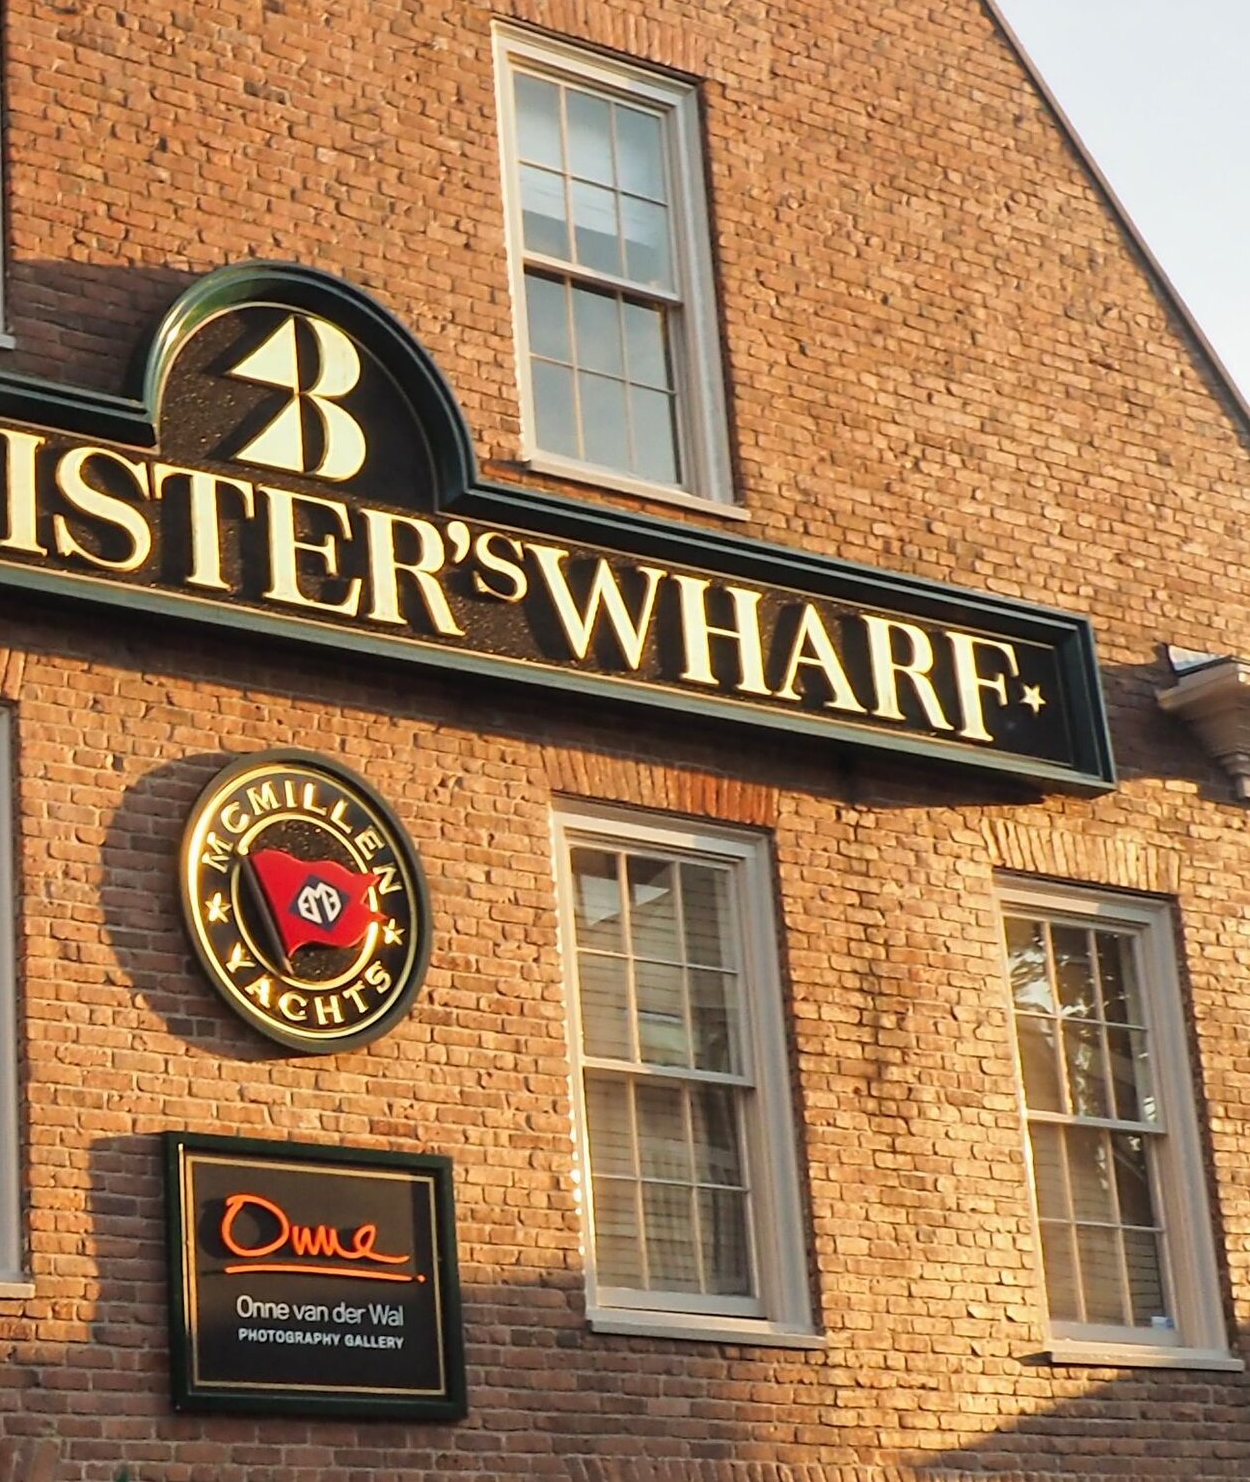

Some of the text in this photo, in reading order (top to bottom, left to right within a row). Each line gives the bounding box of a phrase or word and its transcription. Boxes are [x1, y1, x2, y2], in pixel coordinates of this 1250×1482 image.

[524, 541, 1020, 743] WHARF
[225, 941, 392, 1026] YACHTS
[236, 1295, 404, 1327] Onne van der Wal
[237, 1327, 405, 1349] PHOTOGRAPHY GALLERY
